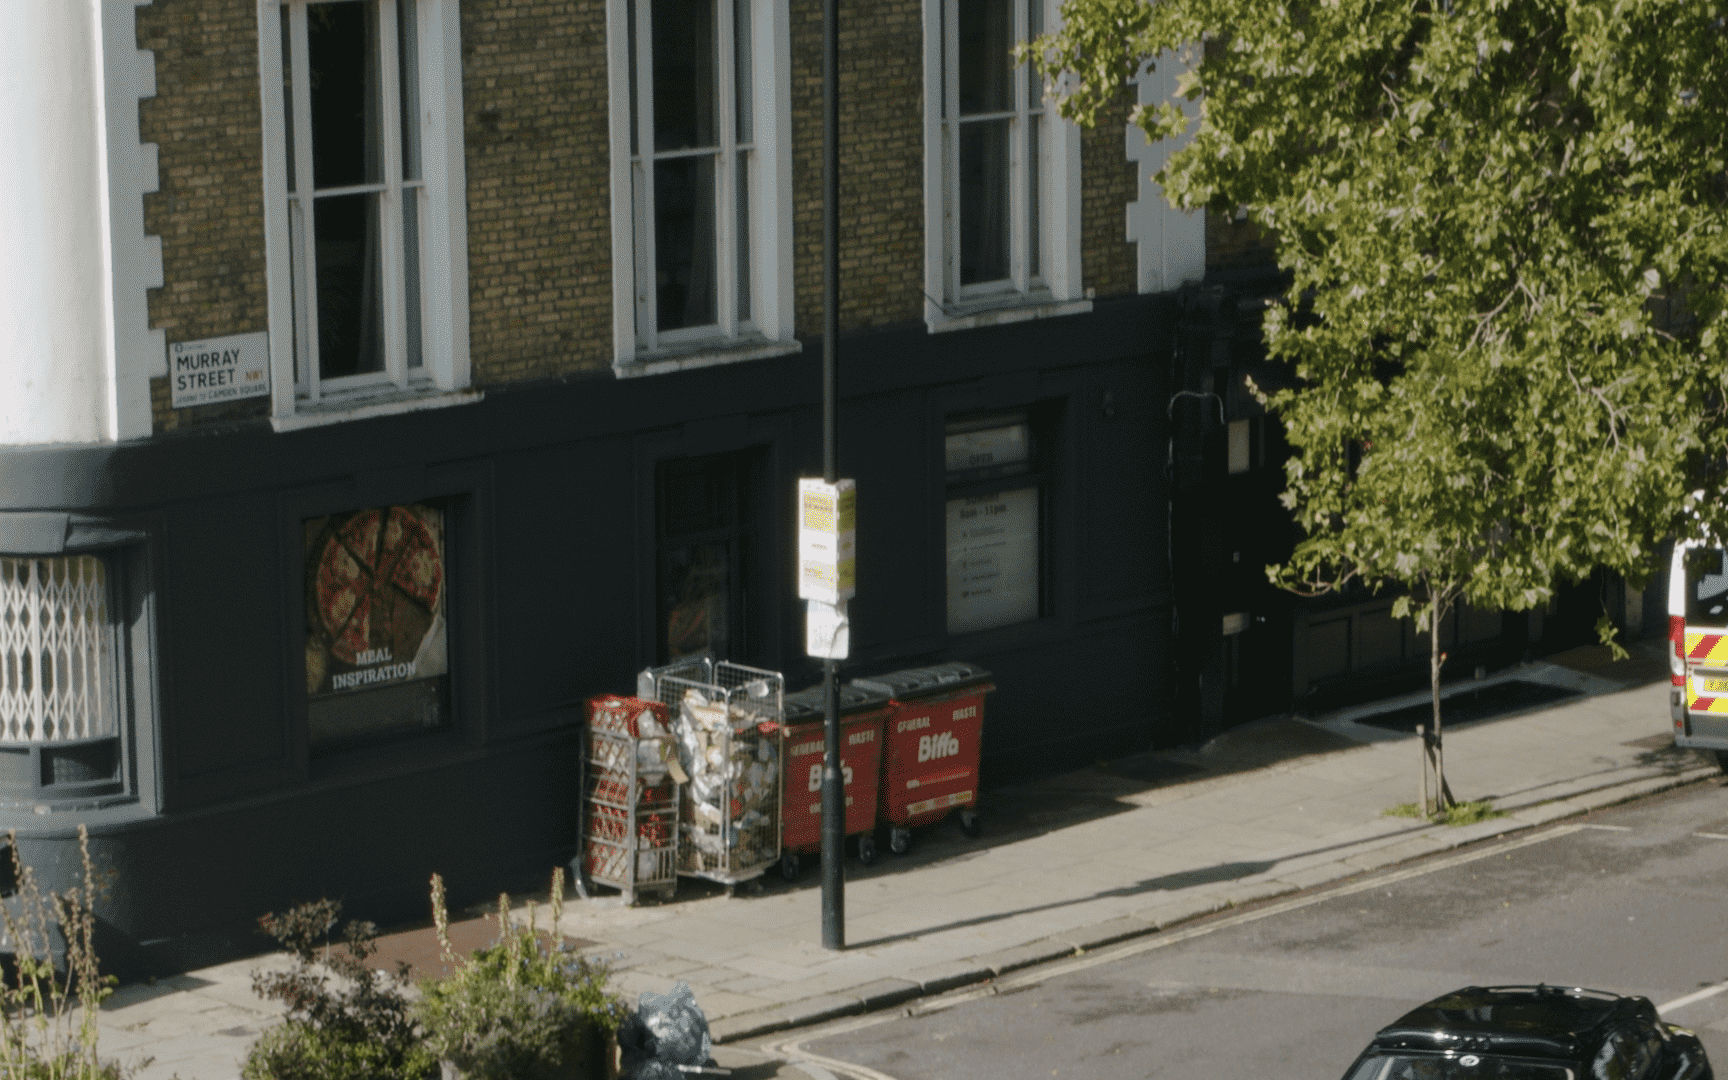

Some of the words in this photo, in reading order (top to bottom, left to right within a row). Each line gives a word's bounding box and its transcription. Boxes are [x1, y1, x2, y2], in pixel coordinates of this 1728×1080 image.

[177, 348, 240, 371] MURRAY
[177, 368, 236, 391] STREET
[245, 369, 263, 381] NW1
[208, 387, 238, 399] CAMDEN
[240, 383, 267, 395] SQUARE
[356, 647, 392, 666] MEAL
[333, 661, 416, 690] INSPIRATION
[897, 716, 930, 734] GENERAL
[952, 705, 977, 721] WASTE
[848, 729, 875, 745] WASTE
[917, 730, 960, 763] Biffa
